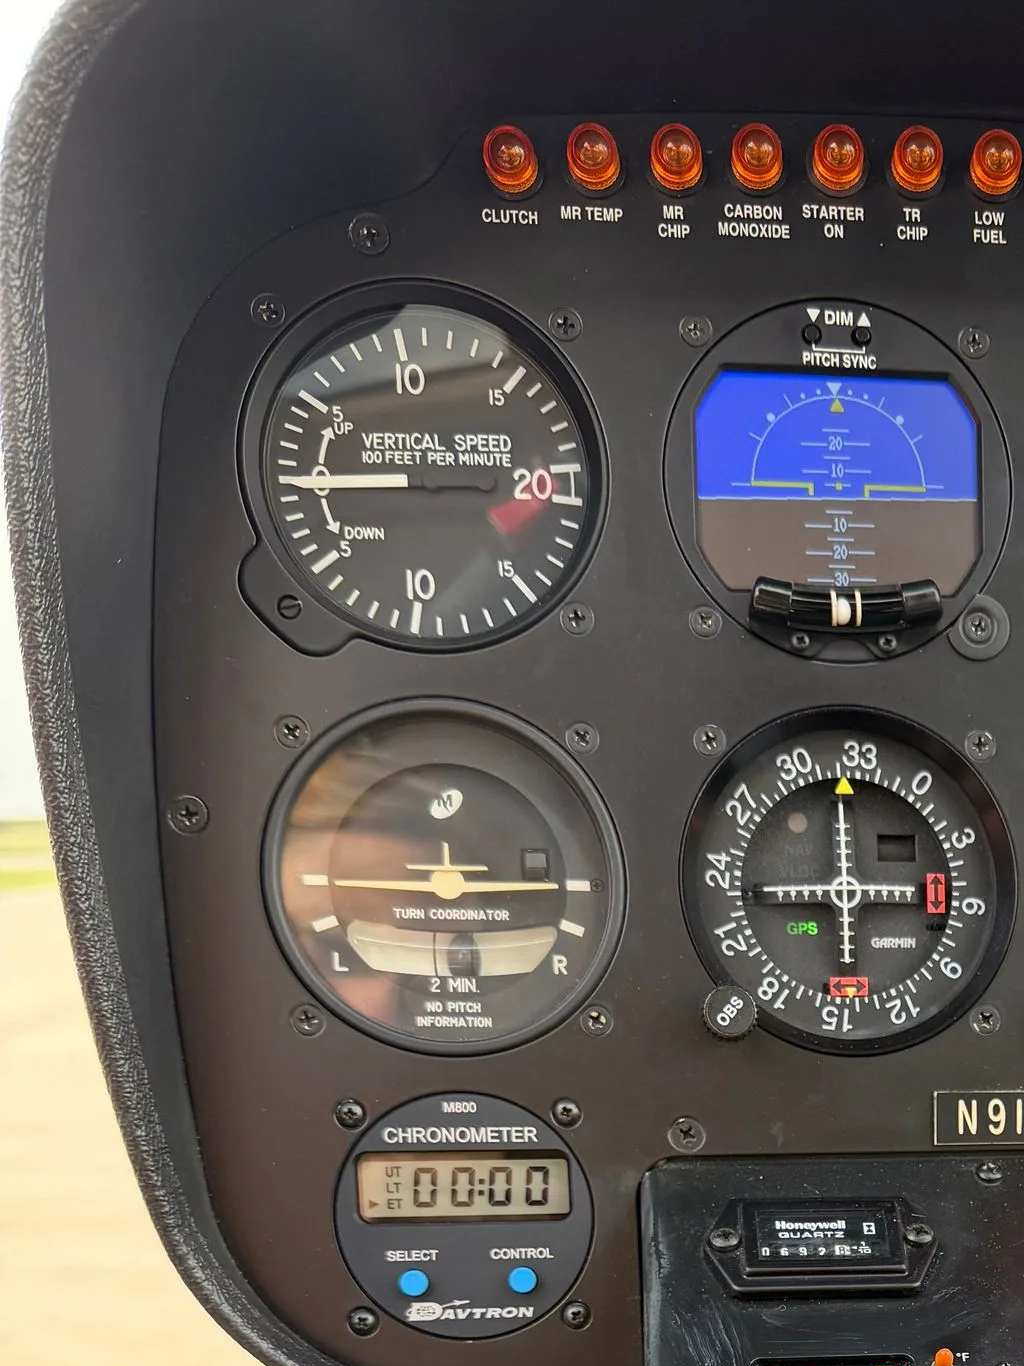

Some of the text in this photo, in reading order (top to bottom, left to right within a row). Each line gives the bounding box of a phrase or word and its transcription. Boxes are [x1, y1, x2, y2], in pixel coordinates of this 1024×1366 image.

[481, 208, 538, 225] CLUTCH
[560, 206, 623, 222] MR TEMP
[663, 205, 684, 219] MR
[724, 204, 783, 221] CARBON
[801, 205, 865, 222] STARTER
[902, 208, 921, 223] TR
[974, 211, 1005, 227] LOW
[658, 223, 691, 239] CHIP
[718, 222, 790, 239] MONOXIDE
[824, 223, 844, 239] ON
[896, 225, 928, 241] CHIP
[973, 228, 1007, 245] FUEL
[824, 310, 854, 327] DIM
[802, 351, 877, 370] PITCH SYNC
[334, 422, 354, 435] UP
[361, 432, 512, 453] VERTICAL SPEED
[828, 436, 843, 451] 20
[362, 450, 512, 468] 100 FEET PER MINUTE
[512, 468, 552, 501] 20
[344, 527, 385, 541] DOWN
[842, 740, 878, 770] 33
[393, 908, 510, 921] TURN COORDINATOR
[786, 922, 818, 936] GPS
[871, 936, 917, 949] GARMIN
[431, 978, 480, 994] 2 MIN.
[426, 1001, 481, 1014] NO PITCH
[715, 994, 745, 1028] OBS
[416, 1015, 492, 1029] INFORMATION
[443, 1101, 477, 1113] M800
[383, 1127, 539, 1145] CHRONOMETER
[412, 1165, 550, 1208] 00:00
[774, 1219, 846, 1231] Honeywell
[777, 1231, 845, 1239] QUARTZ
[387, 1250, 439, 1262] SELECT
[490, 1247, 554, 1260] CONTROL
